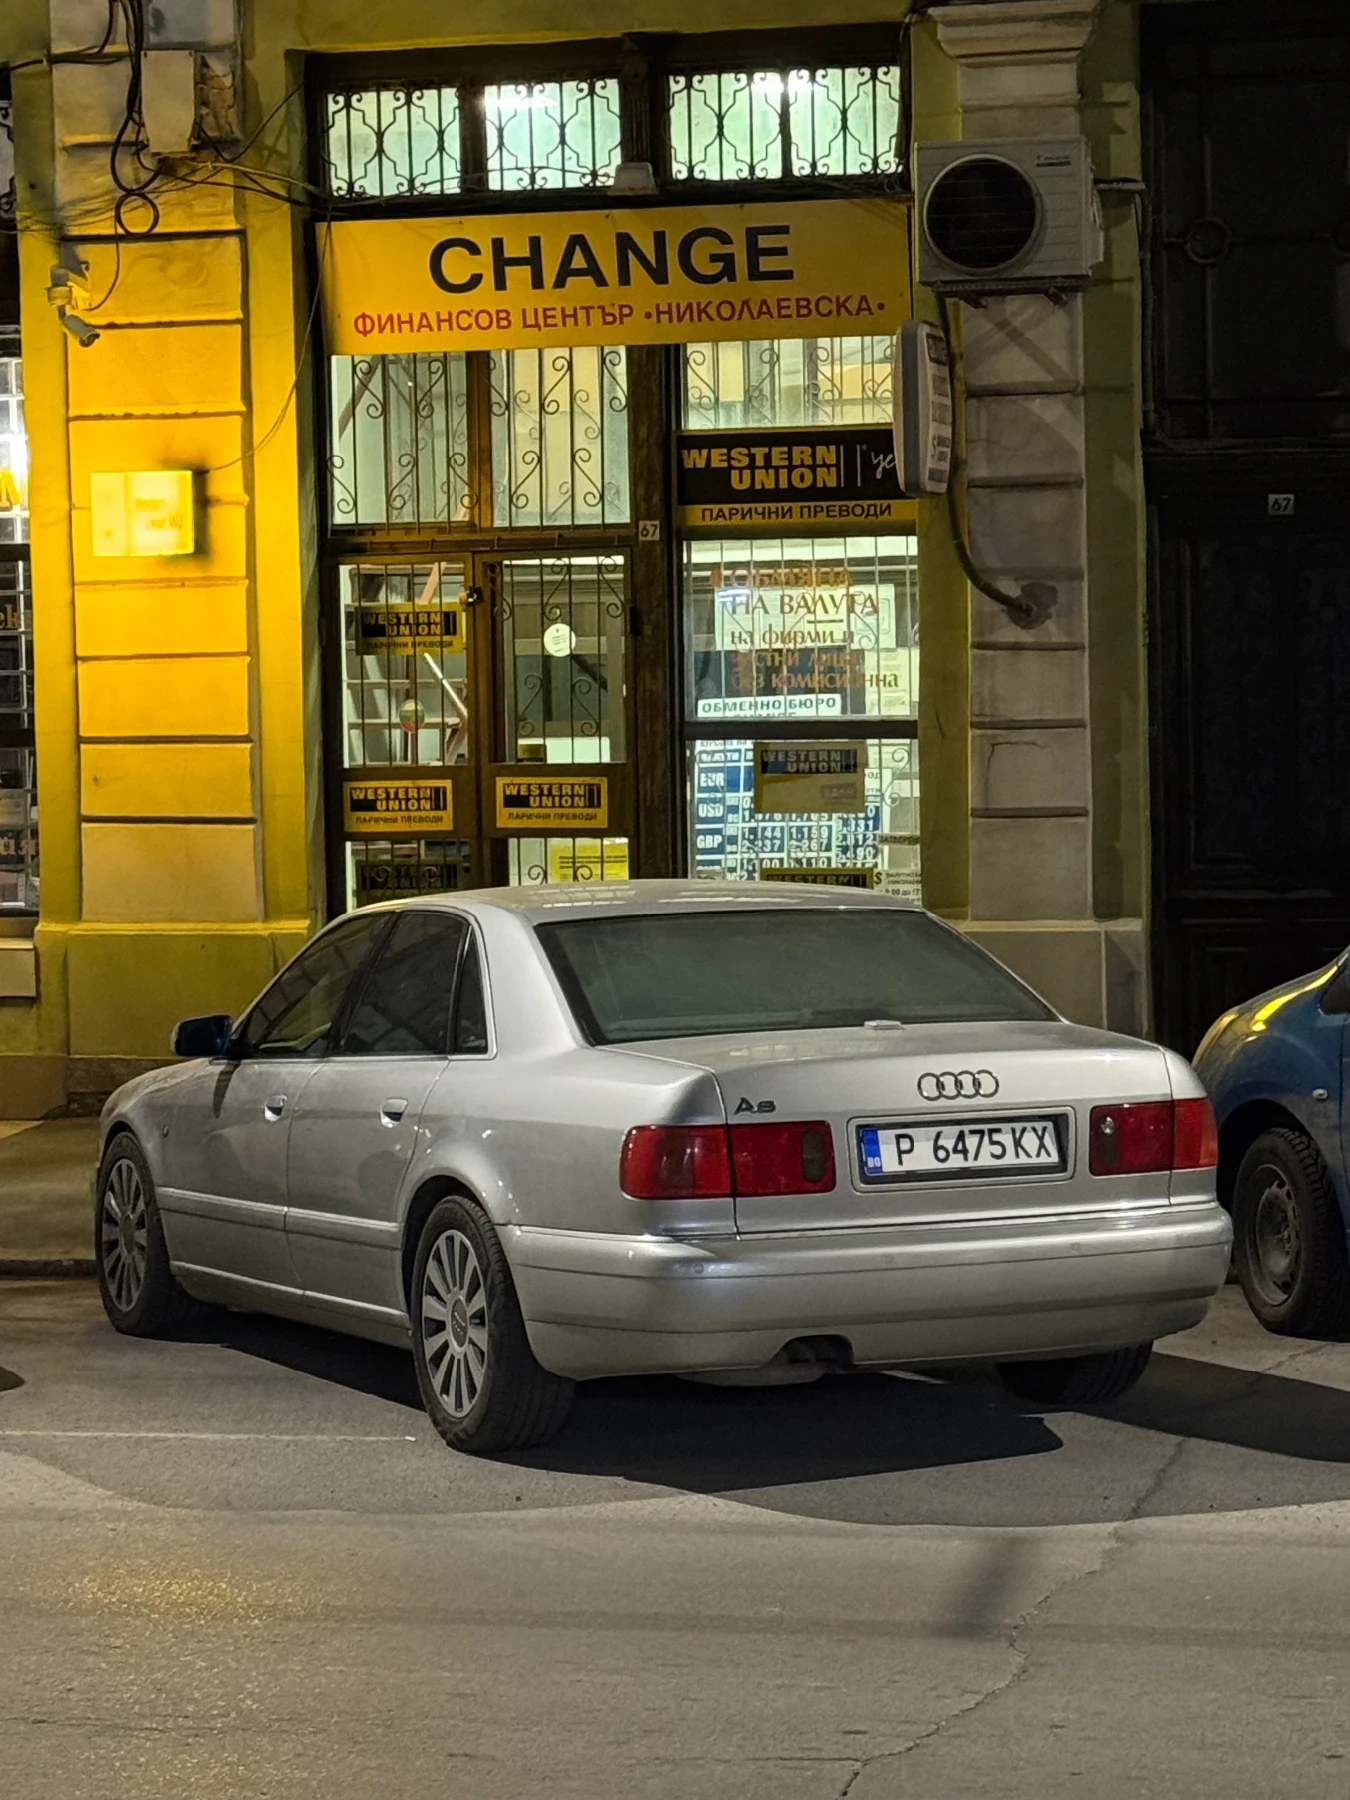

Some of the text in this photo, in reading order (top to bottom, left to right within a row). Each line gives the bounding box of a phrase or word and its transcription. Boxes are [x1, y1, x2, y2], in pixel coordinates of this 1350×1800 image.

[429, 224, 794, 294] CHANGE
[354, 309, 512, 337] ФИНАНСОВ
[521, 303, 634, 332] ЦЕНТЪР
[683, 445, 836, 468] WESTERN
[731, 467, 836, 490] UNION
[1272, 497, 1292, 511] 67
[701, 503, 891, 521] ПАРИЧНИ ПРЕВОДИ
[640, 524, 659, 538] 67
[732, 594, 878, 615] НА ВАЛУТА
[702, 697, 836, 713] ОБМЕННО БЮРО
[763, 751, 841, 762] WESTERN
[787, 762, 841, 773] UNION
[700, 773, 725, 787] EUR
[352, 787, 430, 800] WESTERN
[505, 784, 584, 796] WESTERN
[376, 800, 430, 811] UNION
[529, 796, 584, 807] UNION
[698, 803, 723, 817] USD
[697, 835, 722, 849] GBP
